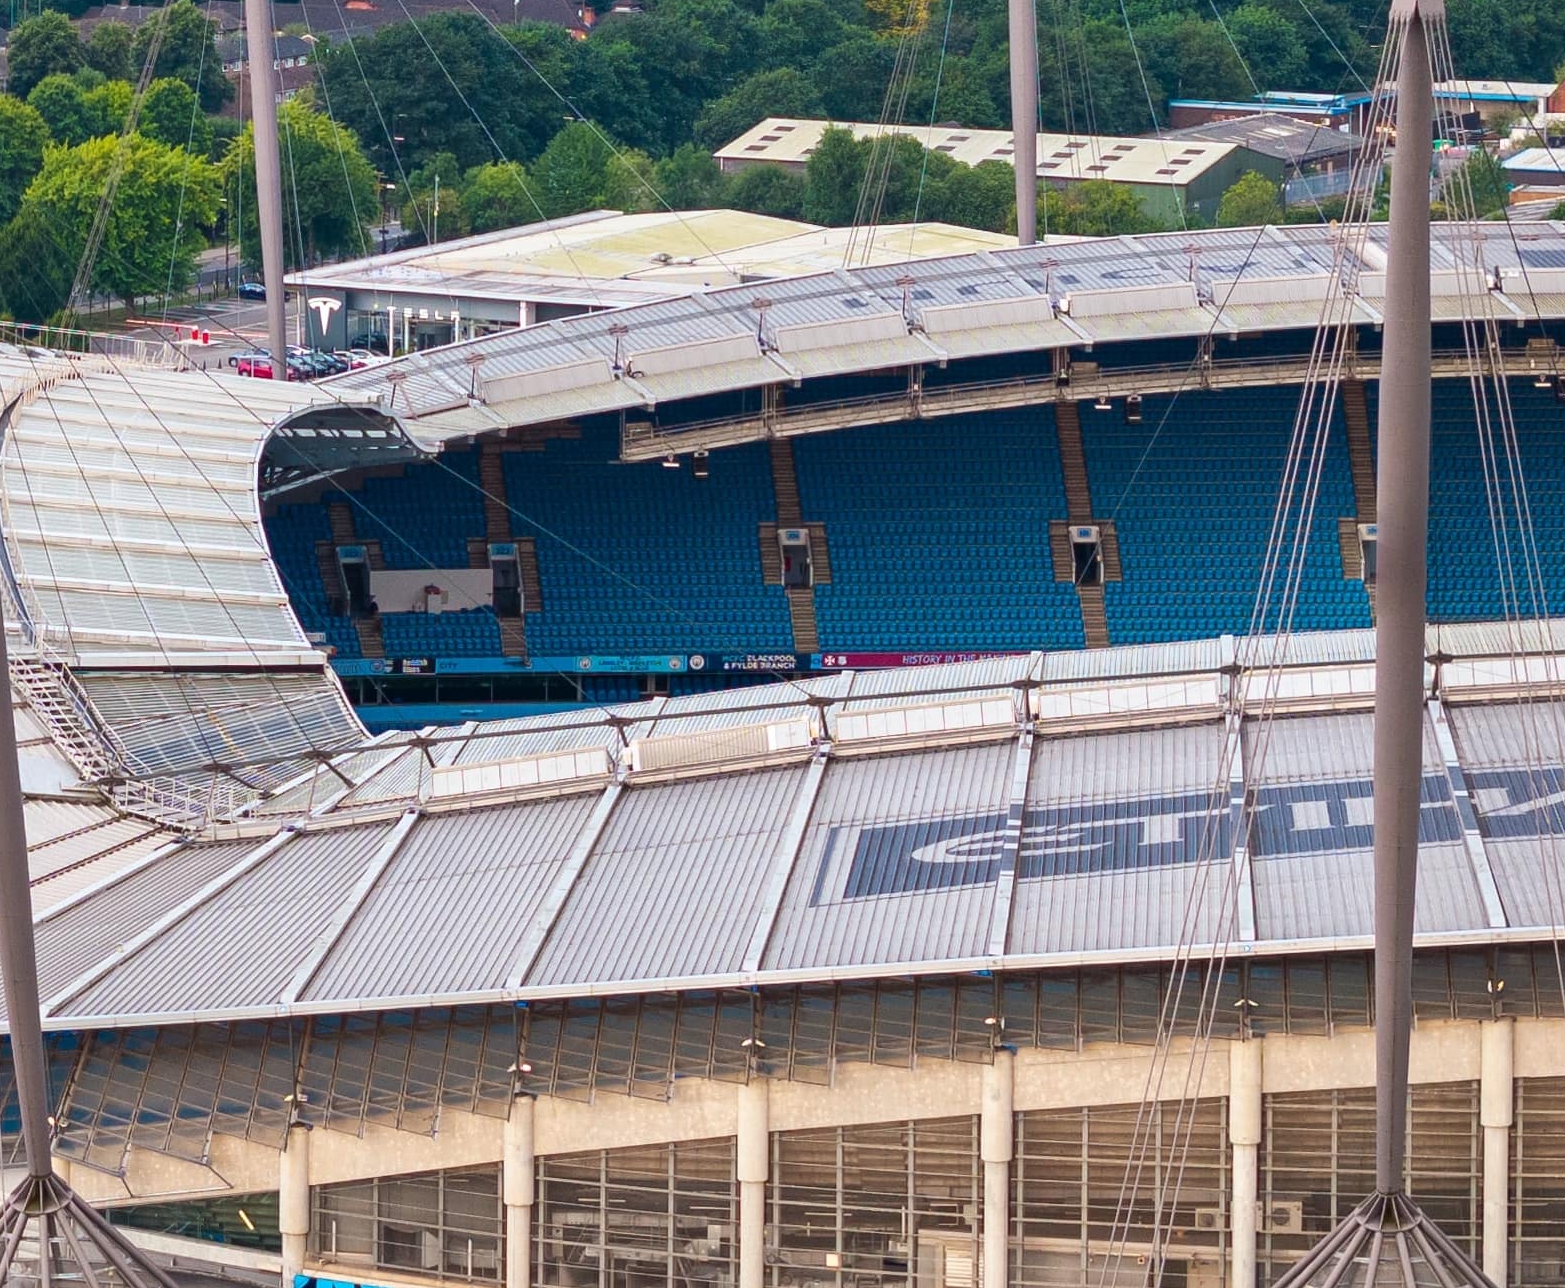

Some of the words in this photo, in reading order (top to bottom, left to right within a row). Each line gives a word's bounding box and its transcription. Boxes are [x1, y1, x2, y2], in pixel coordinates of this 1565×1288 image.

[747, 655, 797, 663] BLACKPOOL
[902, 654, 941, 664] HISTORY
[945, 654, 956, 663] IN
